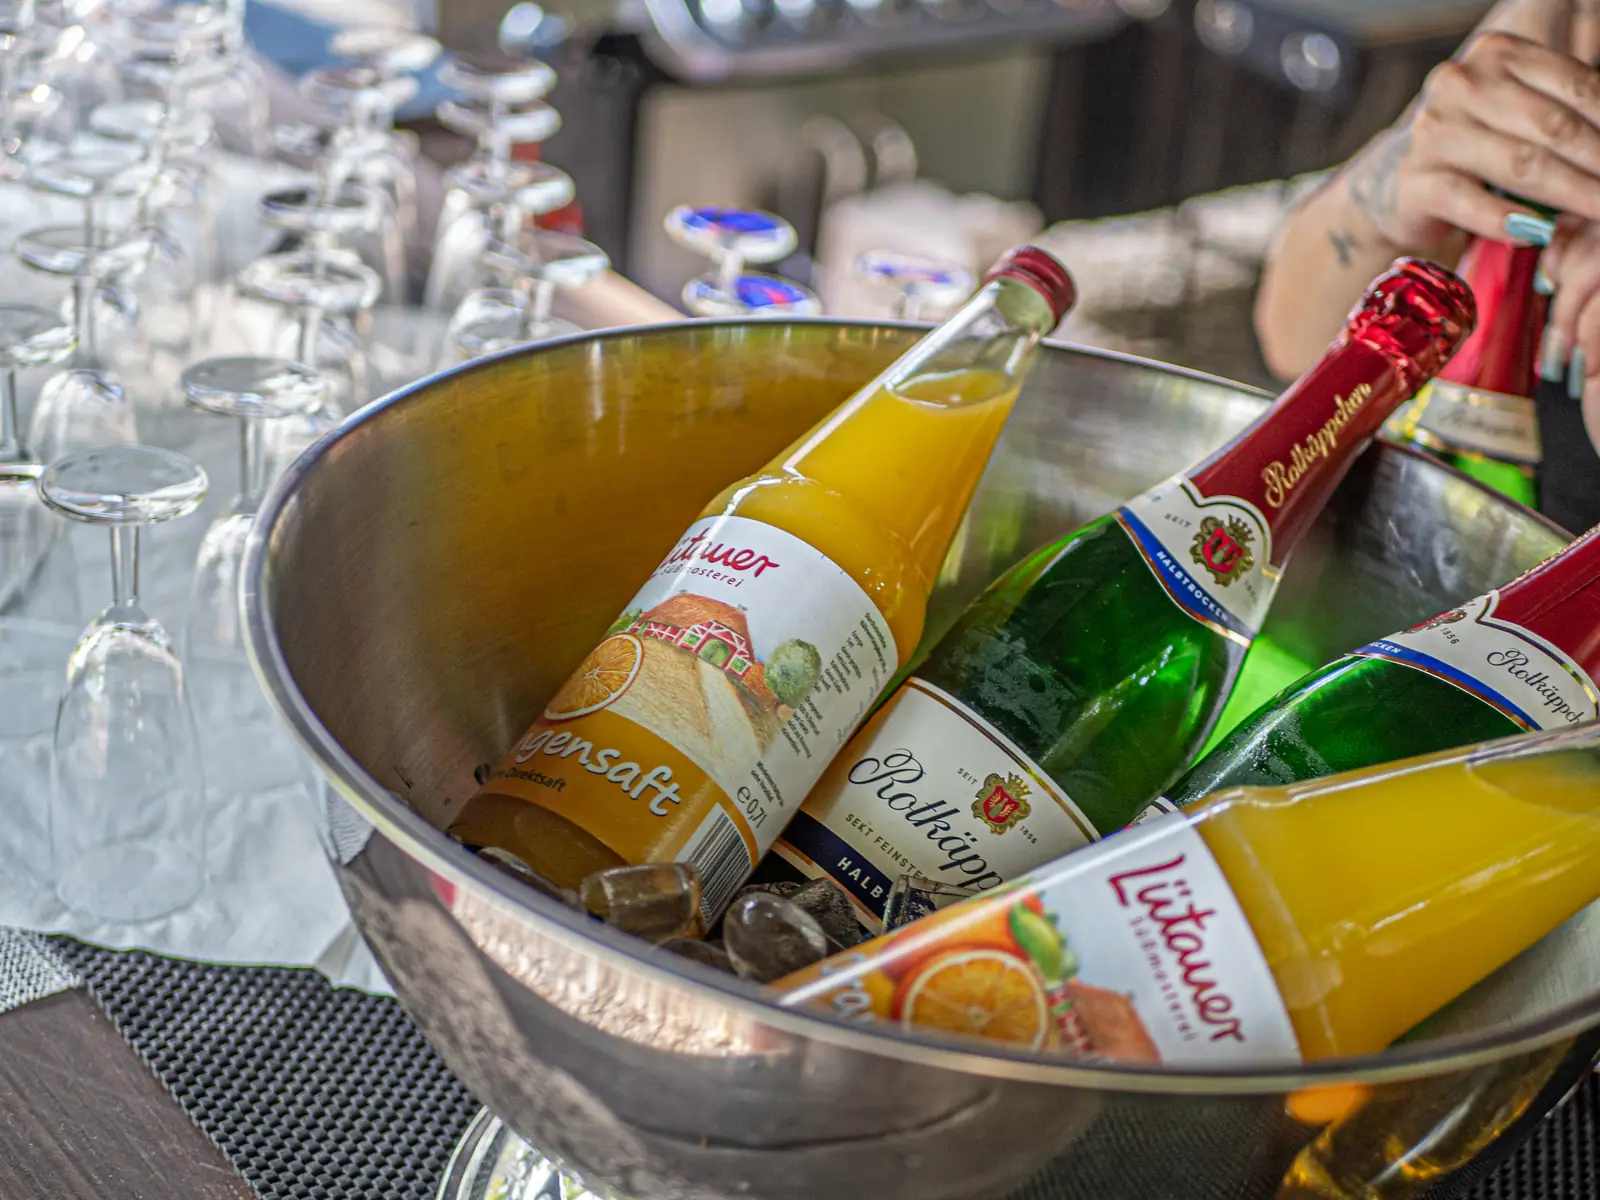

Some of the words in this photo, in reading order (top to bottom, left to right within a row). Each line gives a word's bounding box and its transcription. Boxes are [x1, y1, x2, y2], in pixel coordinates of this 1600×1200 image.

[1164, 513, 1192, 528] SEIT
[1156, 551, 1229, 622] HALBTROCKEN
[1440, 627, 1460, 645] 1856
[957, 767, 979, 785] SEIT
[845, 813, 874, 837] SEKT
[837, 857, 889, 906] HALB
[1108, 853, 1246, 1042] Lütauer
